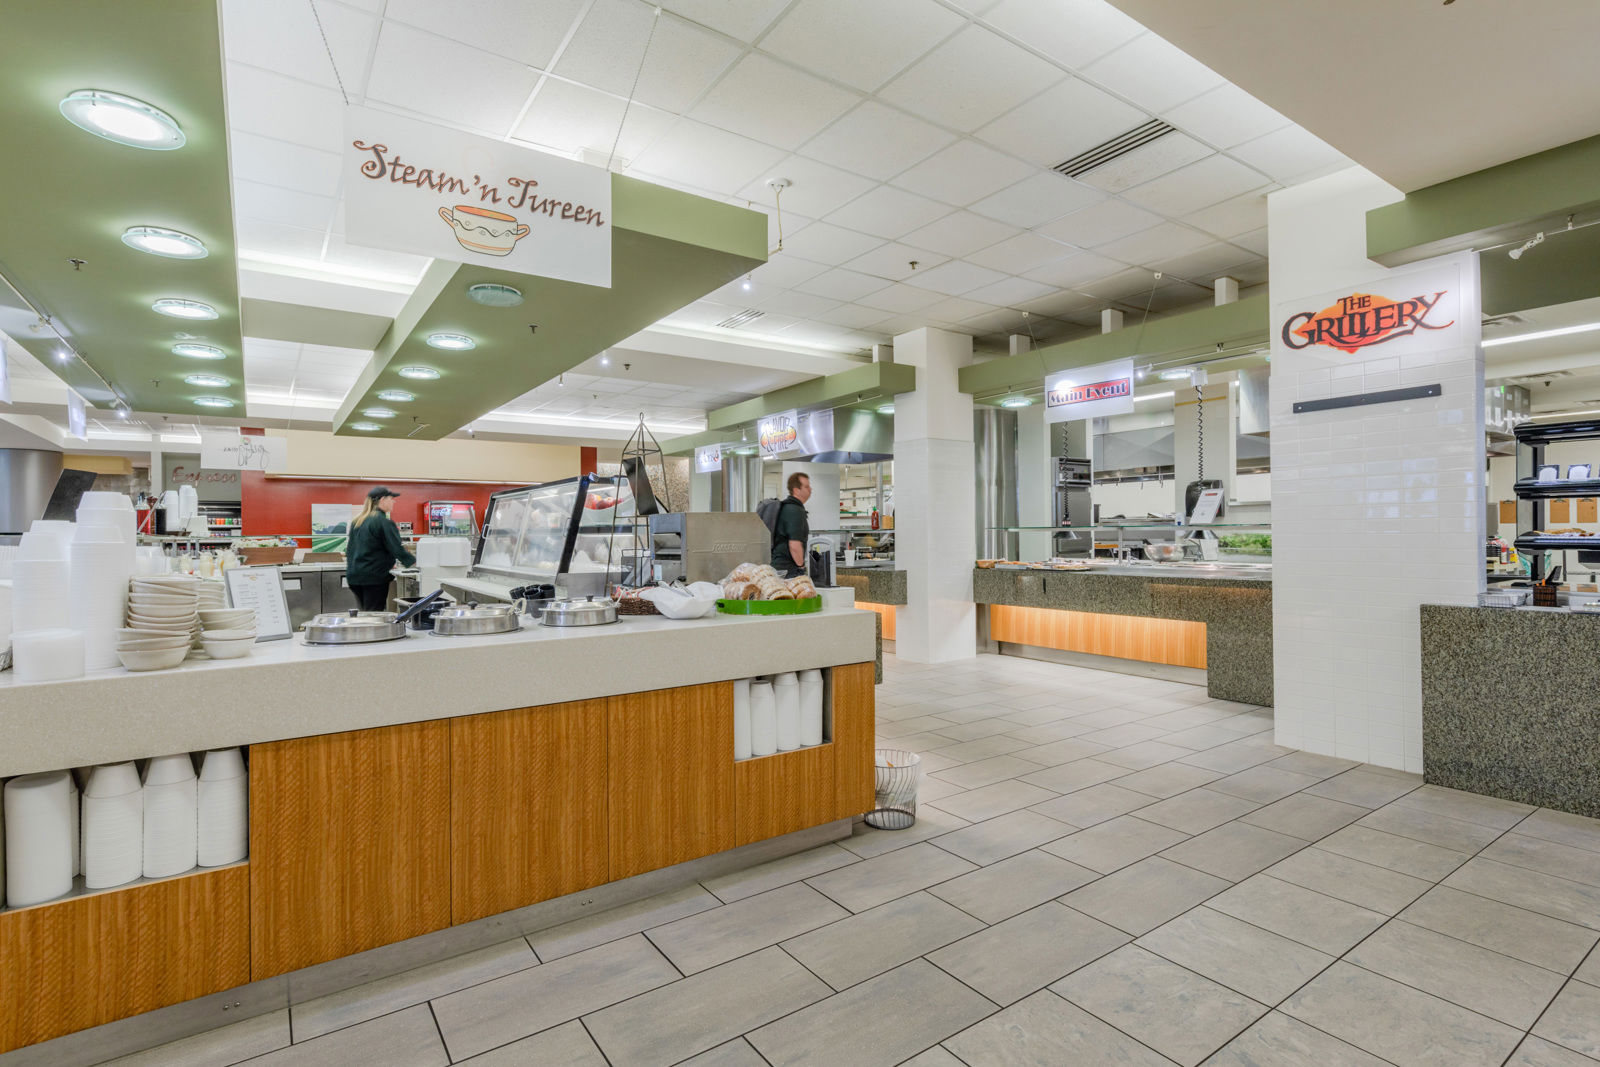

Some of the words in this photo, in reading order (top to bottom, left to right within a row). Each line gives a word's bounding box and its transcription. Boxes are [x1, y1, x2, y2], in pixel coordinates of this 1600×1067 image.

[352, 140, 470, 194] Steam
[507, 177, 605, 227] Tureen
[1281, 290, 1455, 349] GRILLERY
[1336, 295, 1372, 316] THE
[1086, 382, 1127, 399] Event
